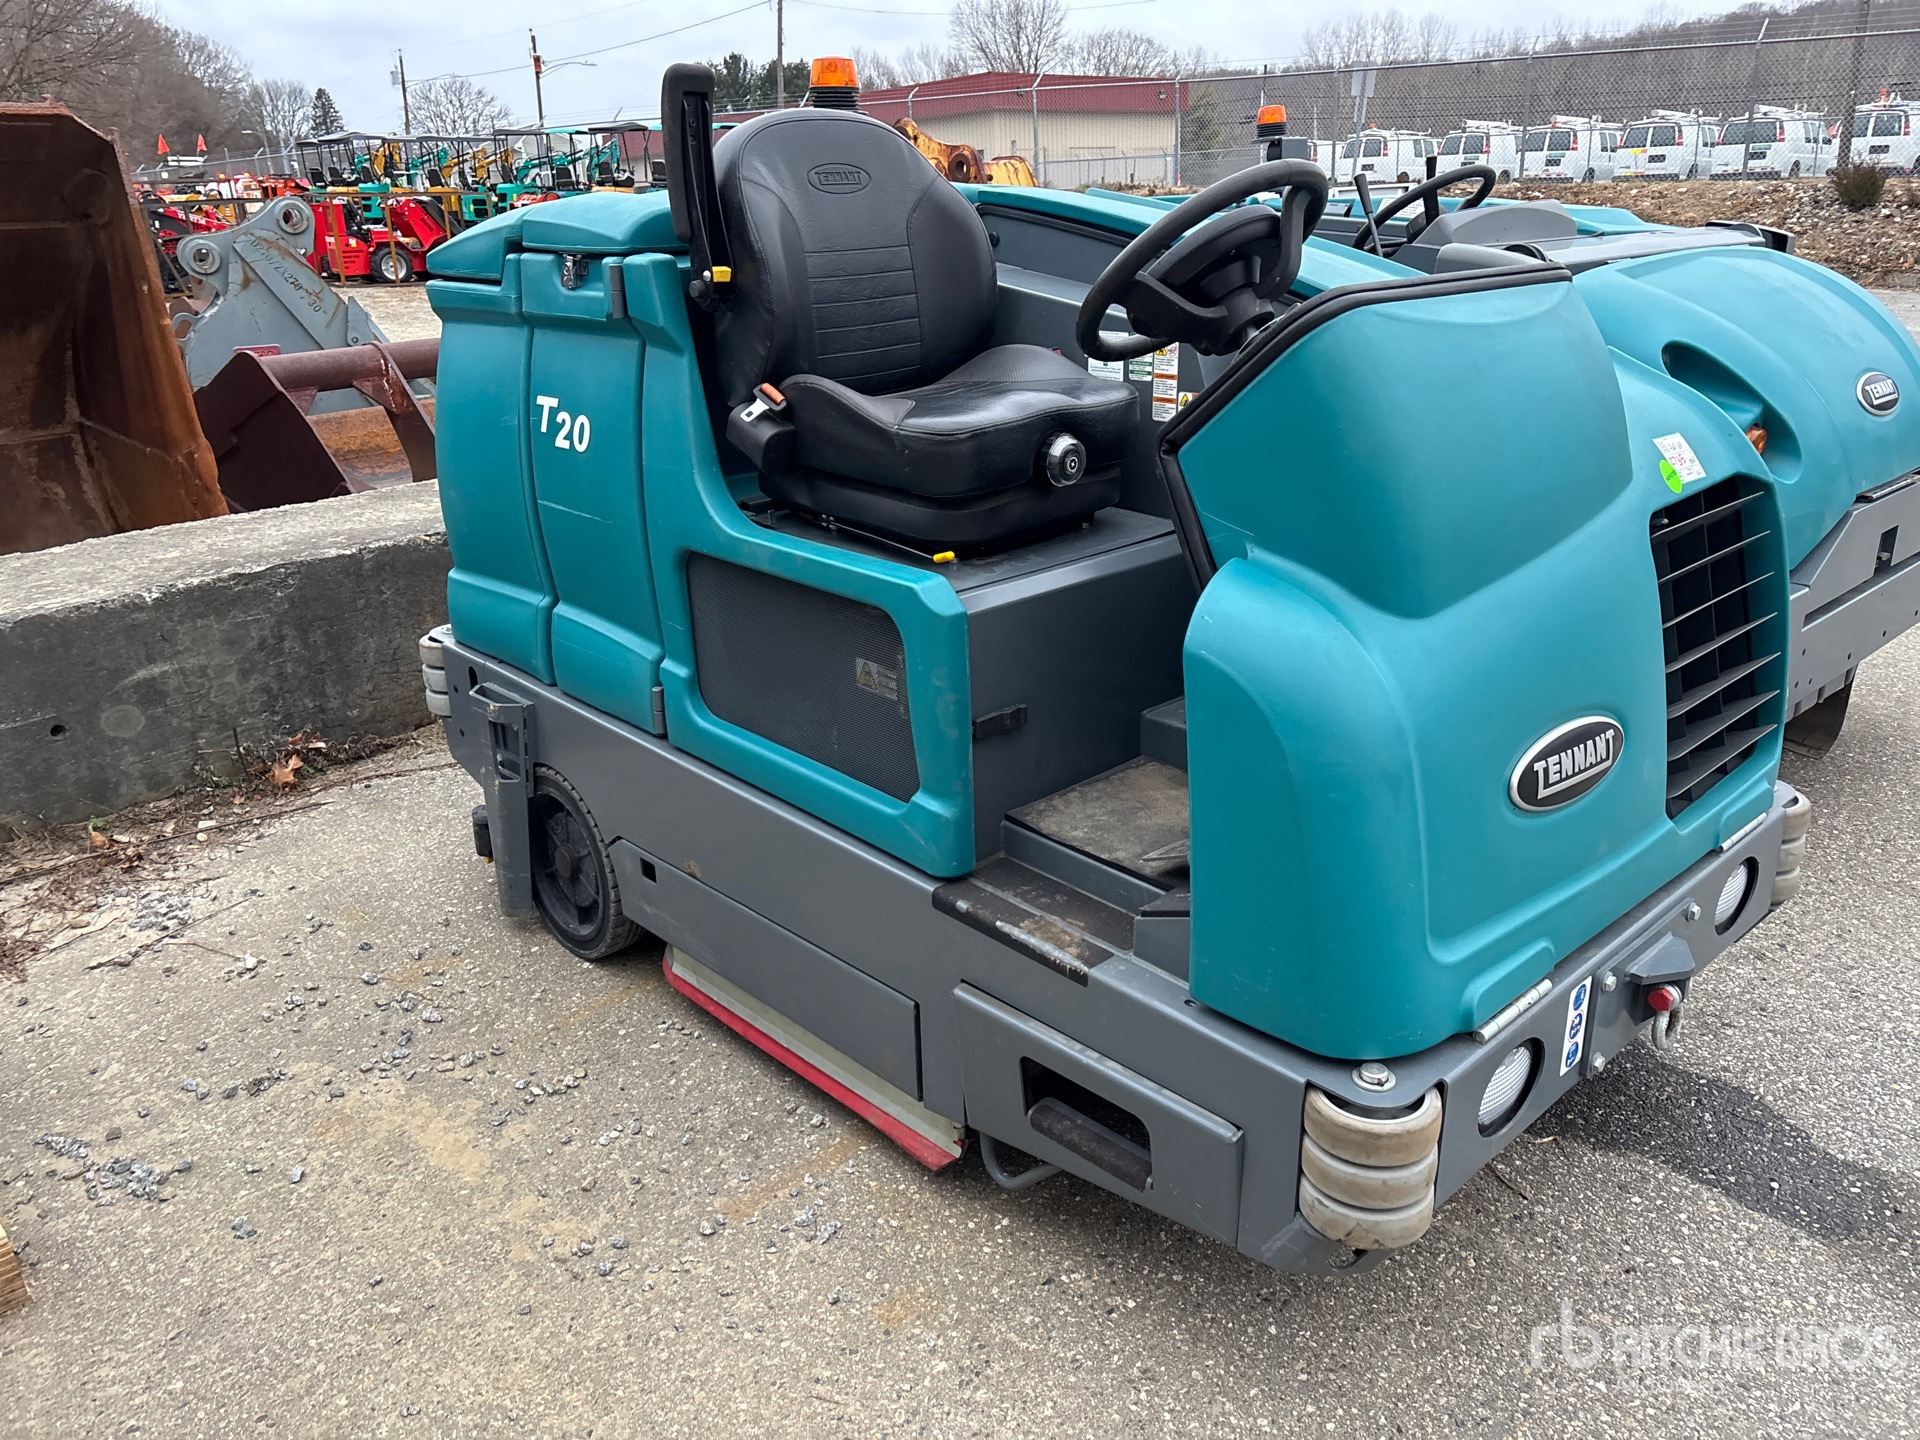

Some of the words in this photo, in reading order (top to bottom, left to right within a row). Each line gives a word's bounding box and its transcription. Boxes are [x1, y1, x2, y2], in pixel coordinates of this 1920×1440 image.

[814, 171, 862, 187] TENNANT
[536, 394, 591, 453] T20
[1533, 728, 1615, 800] TENNANT
